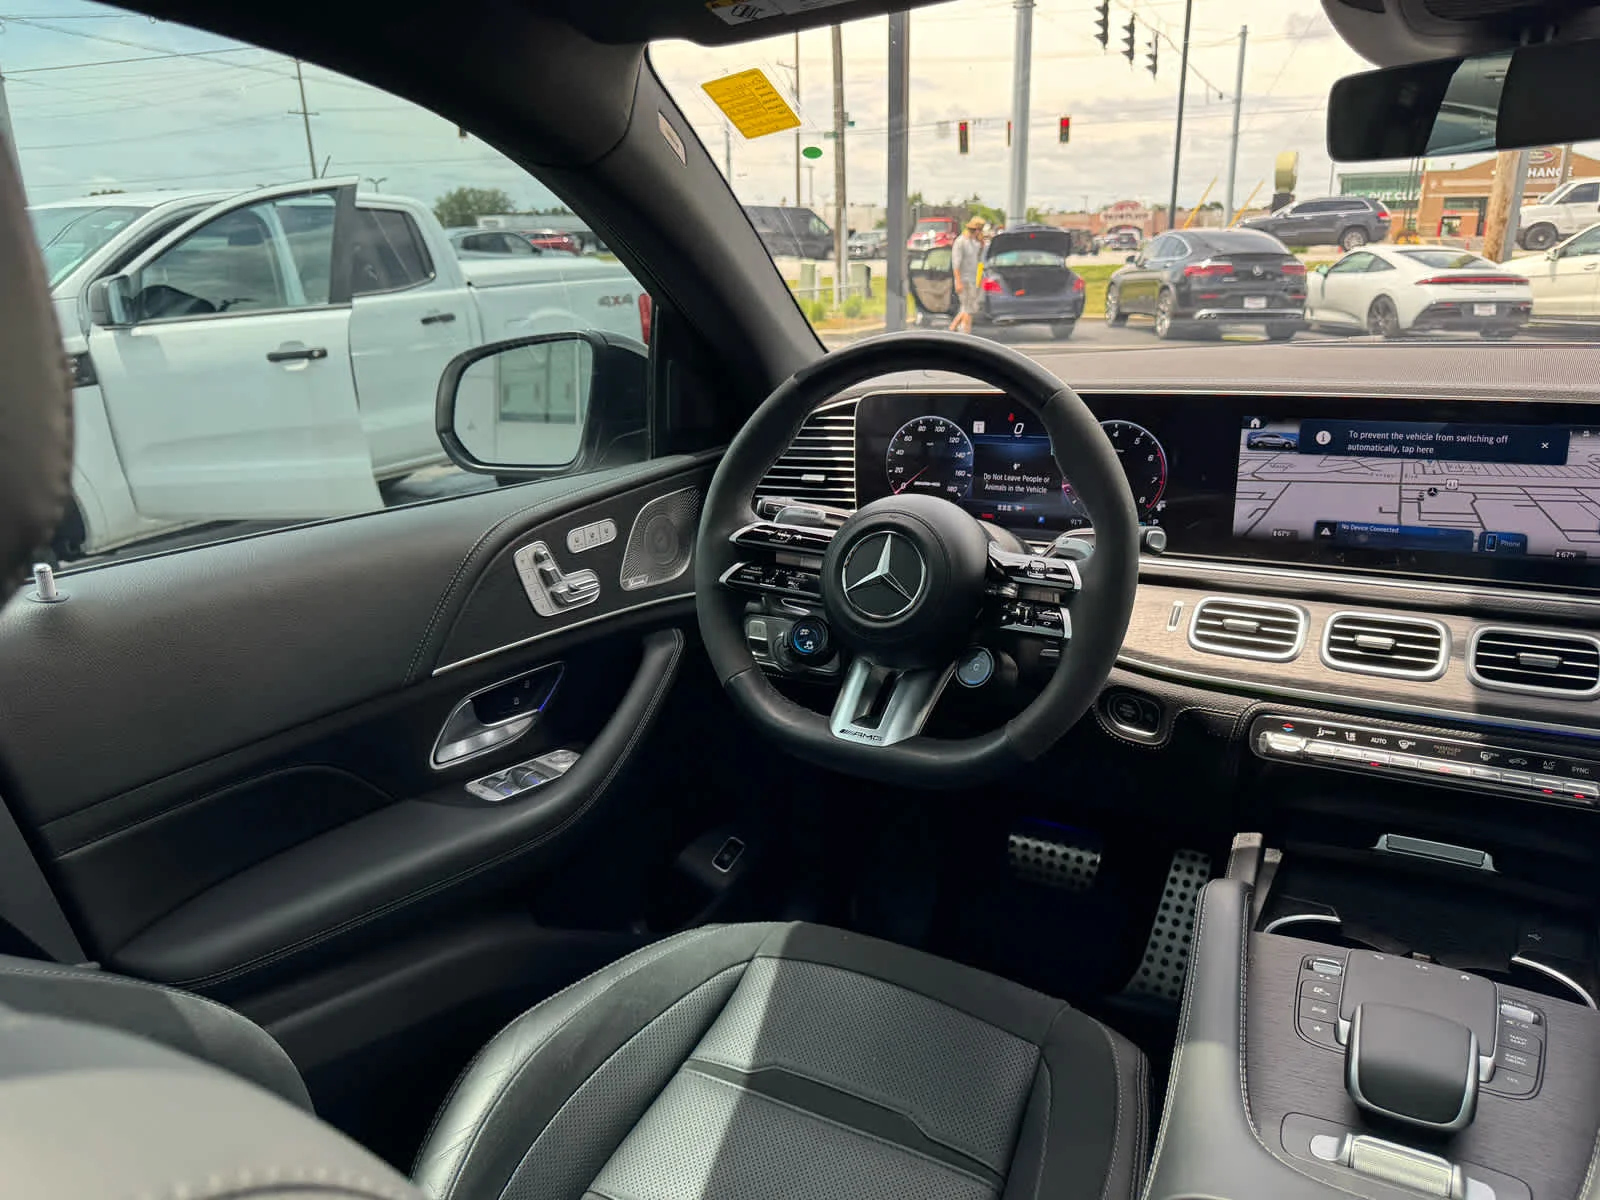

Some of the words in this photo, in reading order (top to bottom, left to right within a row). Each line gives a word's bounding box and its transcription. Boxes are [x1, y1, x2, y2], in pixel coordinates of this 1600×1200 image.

[1013, 422, 1024, 435] 0
[1349, 430, 1358, 438] To
[1360, 431, 1389, 441] prevent
[1391, 431, 1404, 440] the
[1406, 432, 1434, 441] vehicle
[1435, 432, 1454, 441] from
[1456, 434, 1495, 445] switching
[1495, 434, 1509, 444] off
[1347, 444, 1400, 454] automatically,
[1402, 445, 1415, 455] tap
[1416, 445, 1434, 454] here
[894, 466, 904, 474] 20
[983, 472, 991, 480] Do
[992, 473, 1003, 481] Not
[1004, 474, 1021, 482] Leave
[1022, 475, 1042, 484] People
[984, 484, 1007, 492] Animals
[1015, 485, 1025, 493] the
[1026, 486, 1048, 494] Vehicle
[1369, 525, 1400, 534] Connected
[1370, 736, 1388, 745] AUTO
[1571, 766, 1590, 775] SYNC
